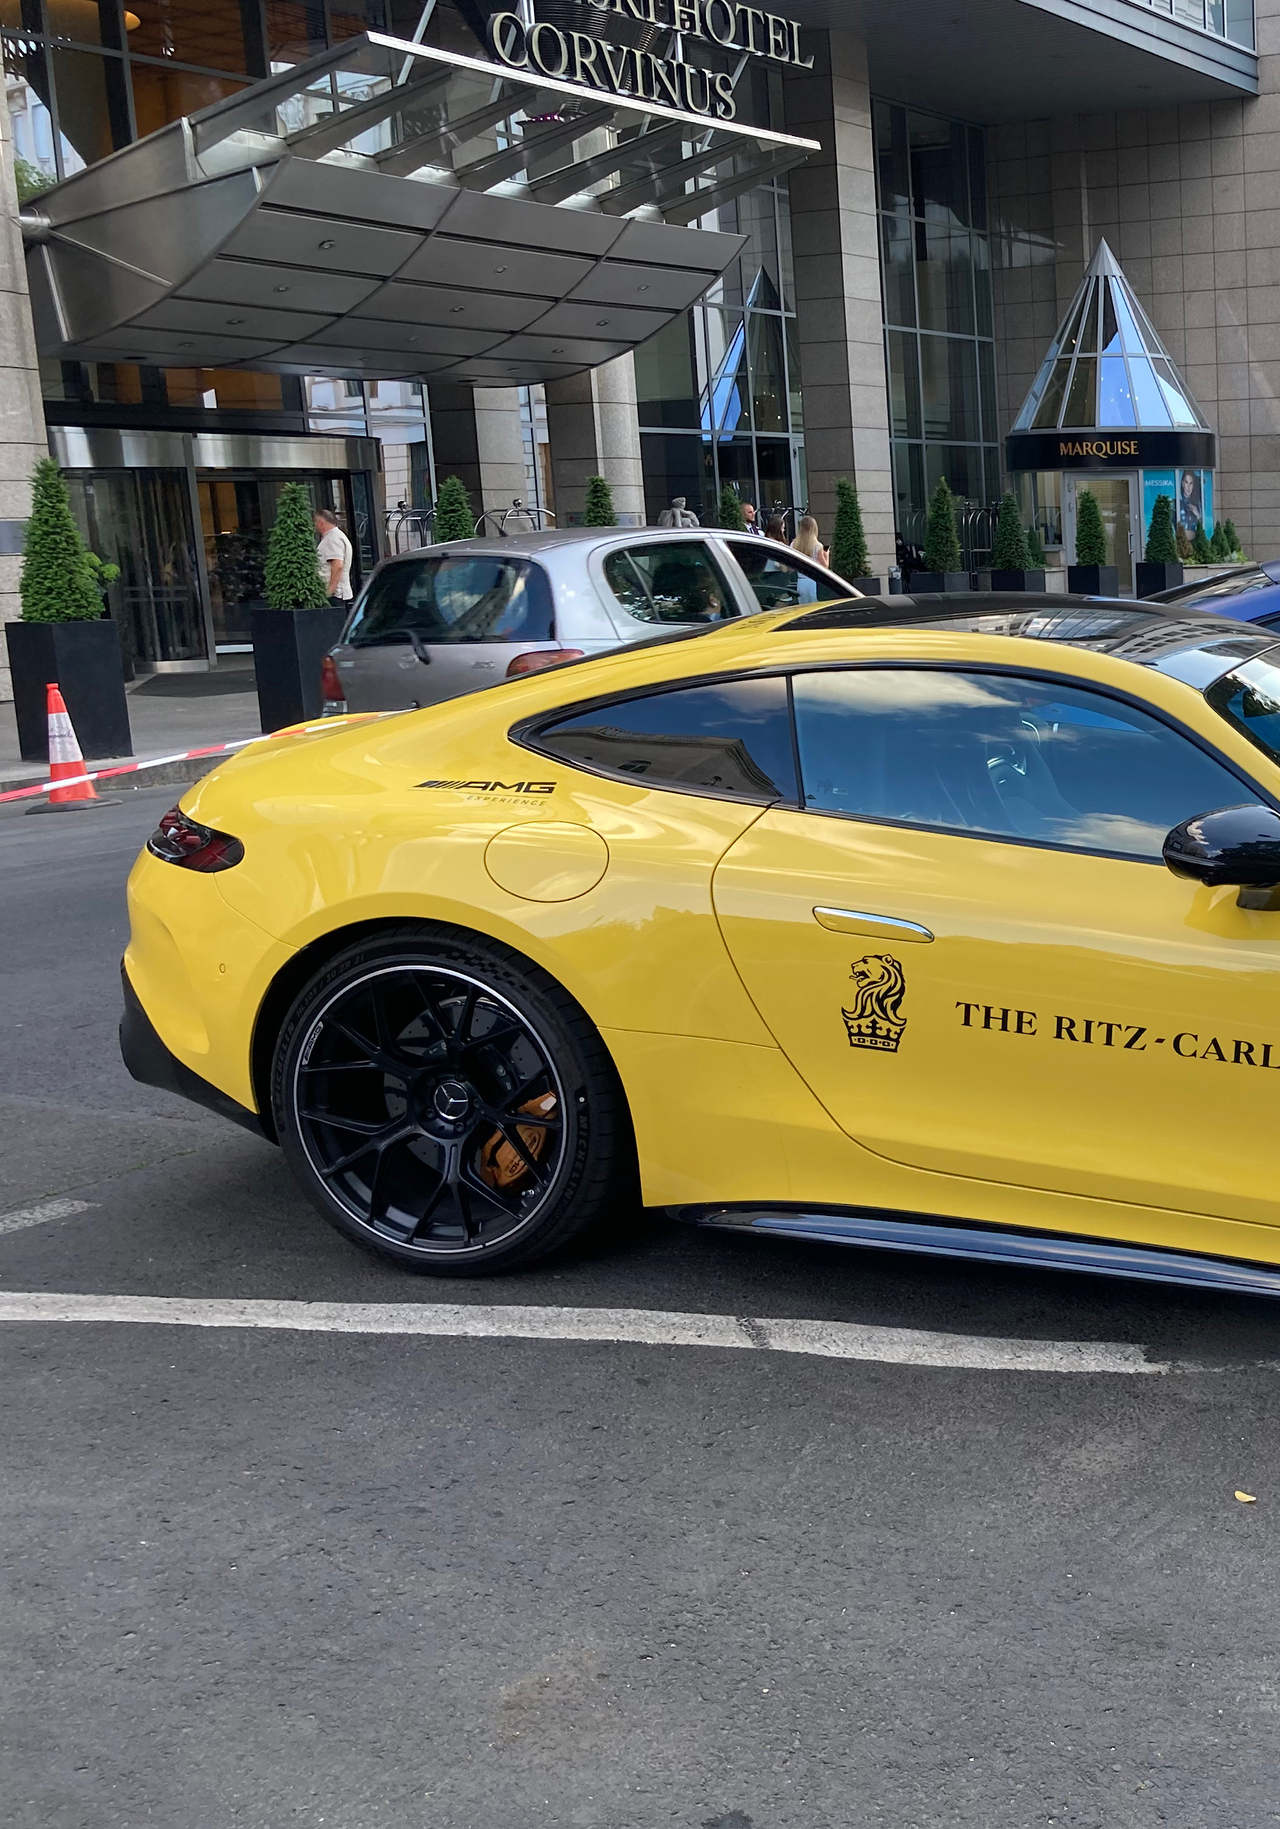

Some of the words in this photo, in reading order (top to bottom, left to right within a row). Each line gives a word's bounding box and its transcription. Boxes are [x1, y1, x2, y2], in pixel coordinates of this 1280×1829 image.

[672, 0, 815, 70] HOTEL
[490, 12, 738, 121] CORVINUS
[1059, 440, 1139, 459] MARQUISE
[1145, 479, 1174, 487] MESSIKA
[459, 781, 557, 794] AMG
[466, 795, 547, 807] EXPERIENCE
[955, 1000, 1038, 1036] THE
